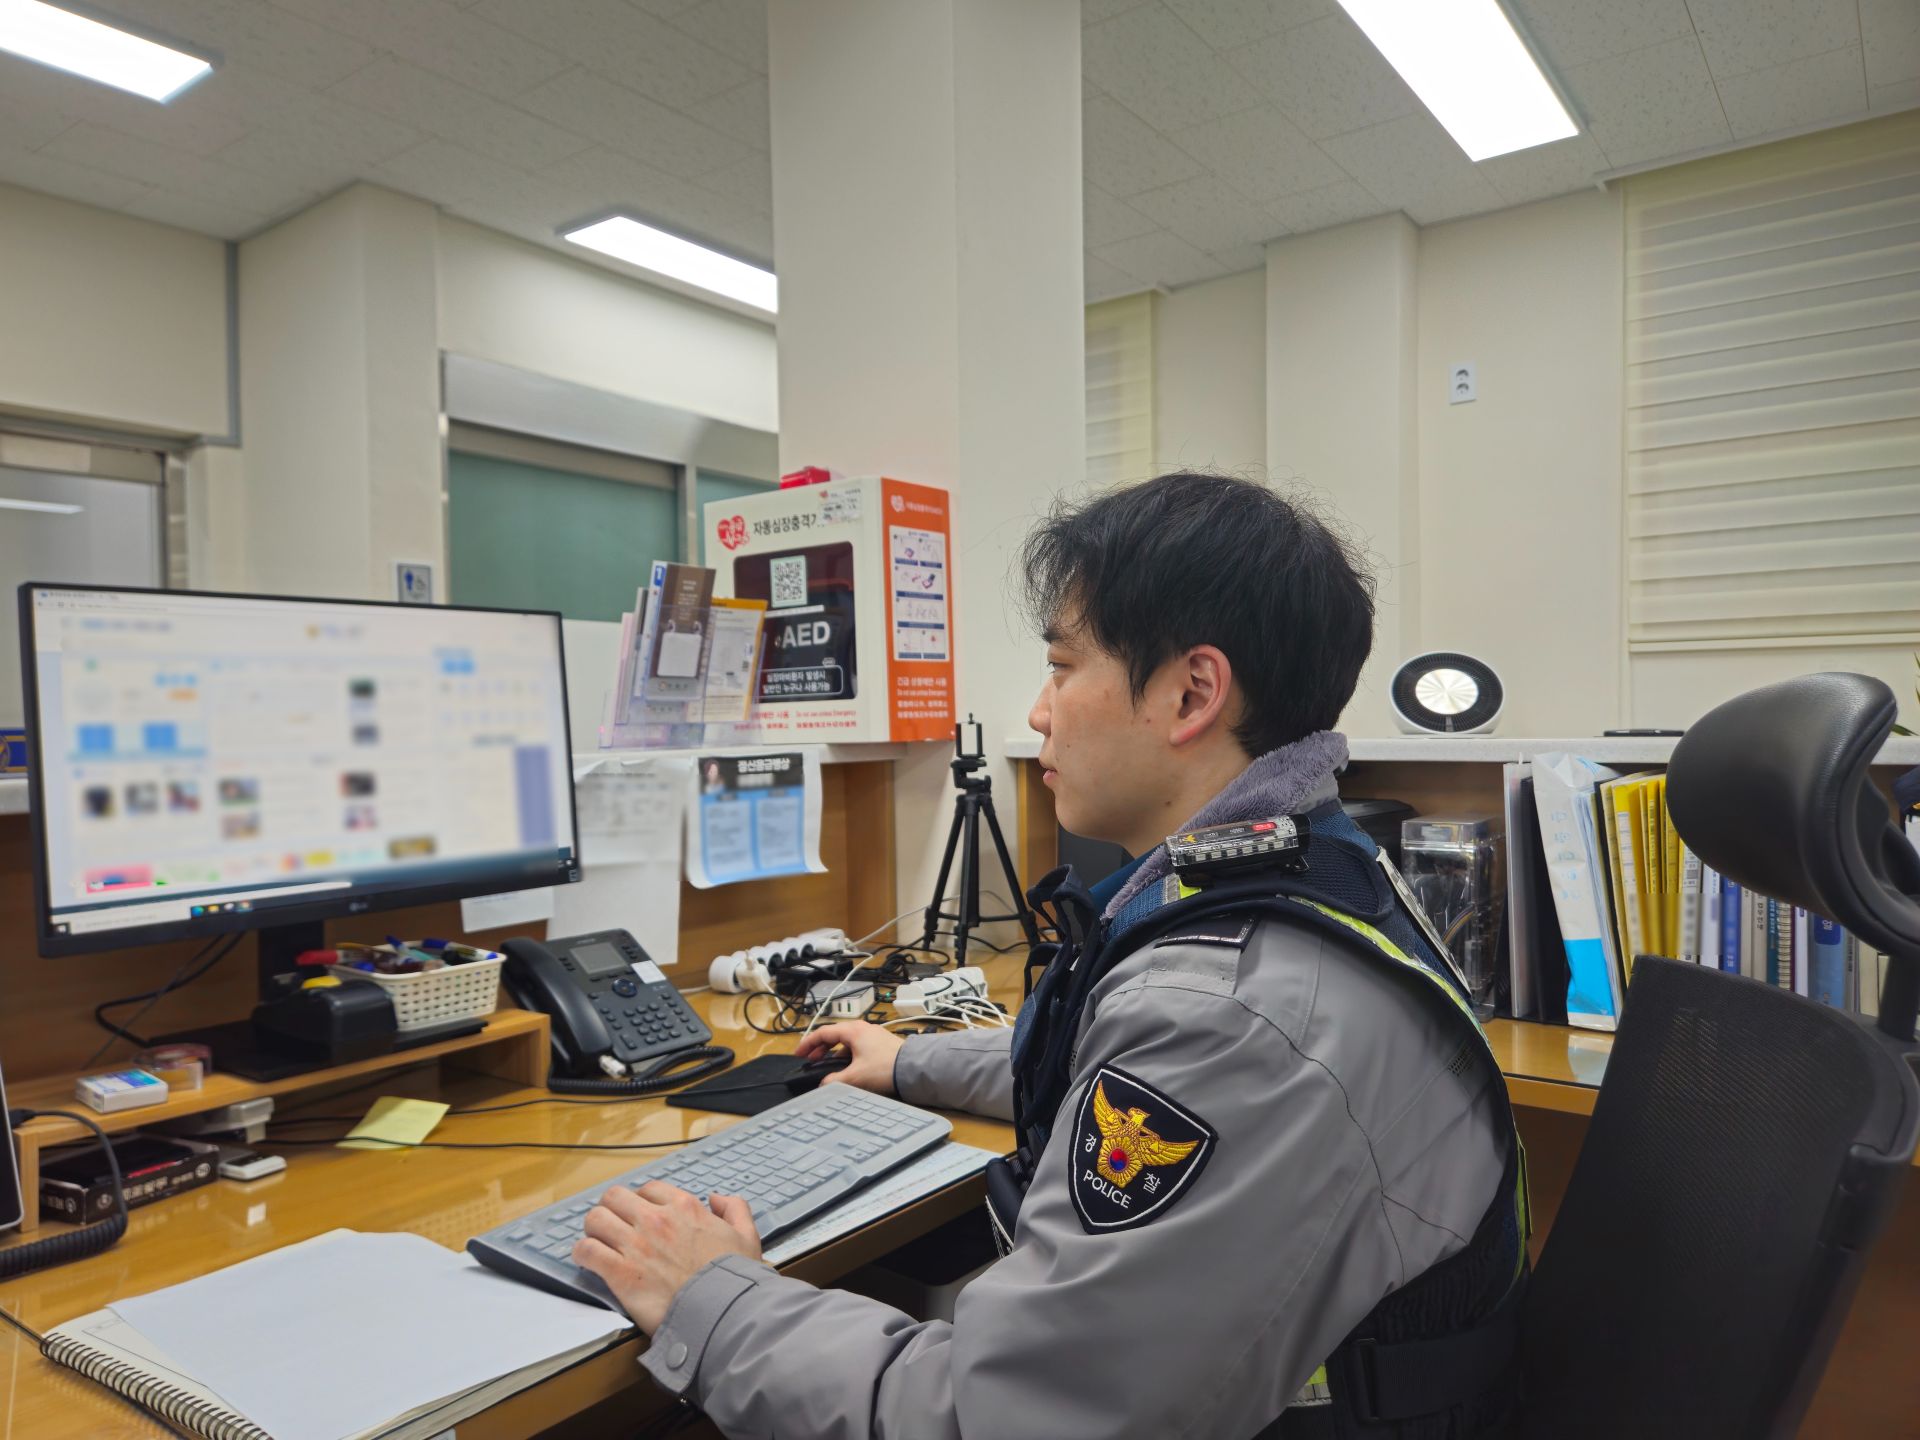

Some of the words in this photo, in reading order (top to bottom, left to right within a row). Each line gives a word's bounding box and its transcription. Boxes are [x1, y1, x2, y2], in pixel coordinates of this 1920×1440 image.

[782, 621, 831, 649] AED
[1085, 1133, 1097, 1153] 경
[1143, 1172, 1161, 1194] 찰
[1083, 1169, 1132, 1209] POLICE
